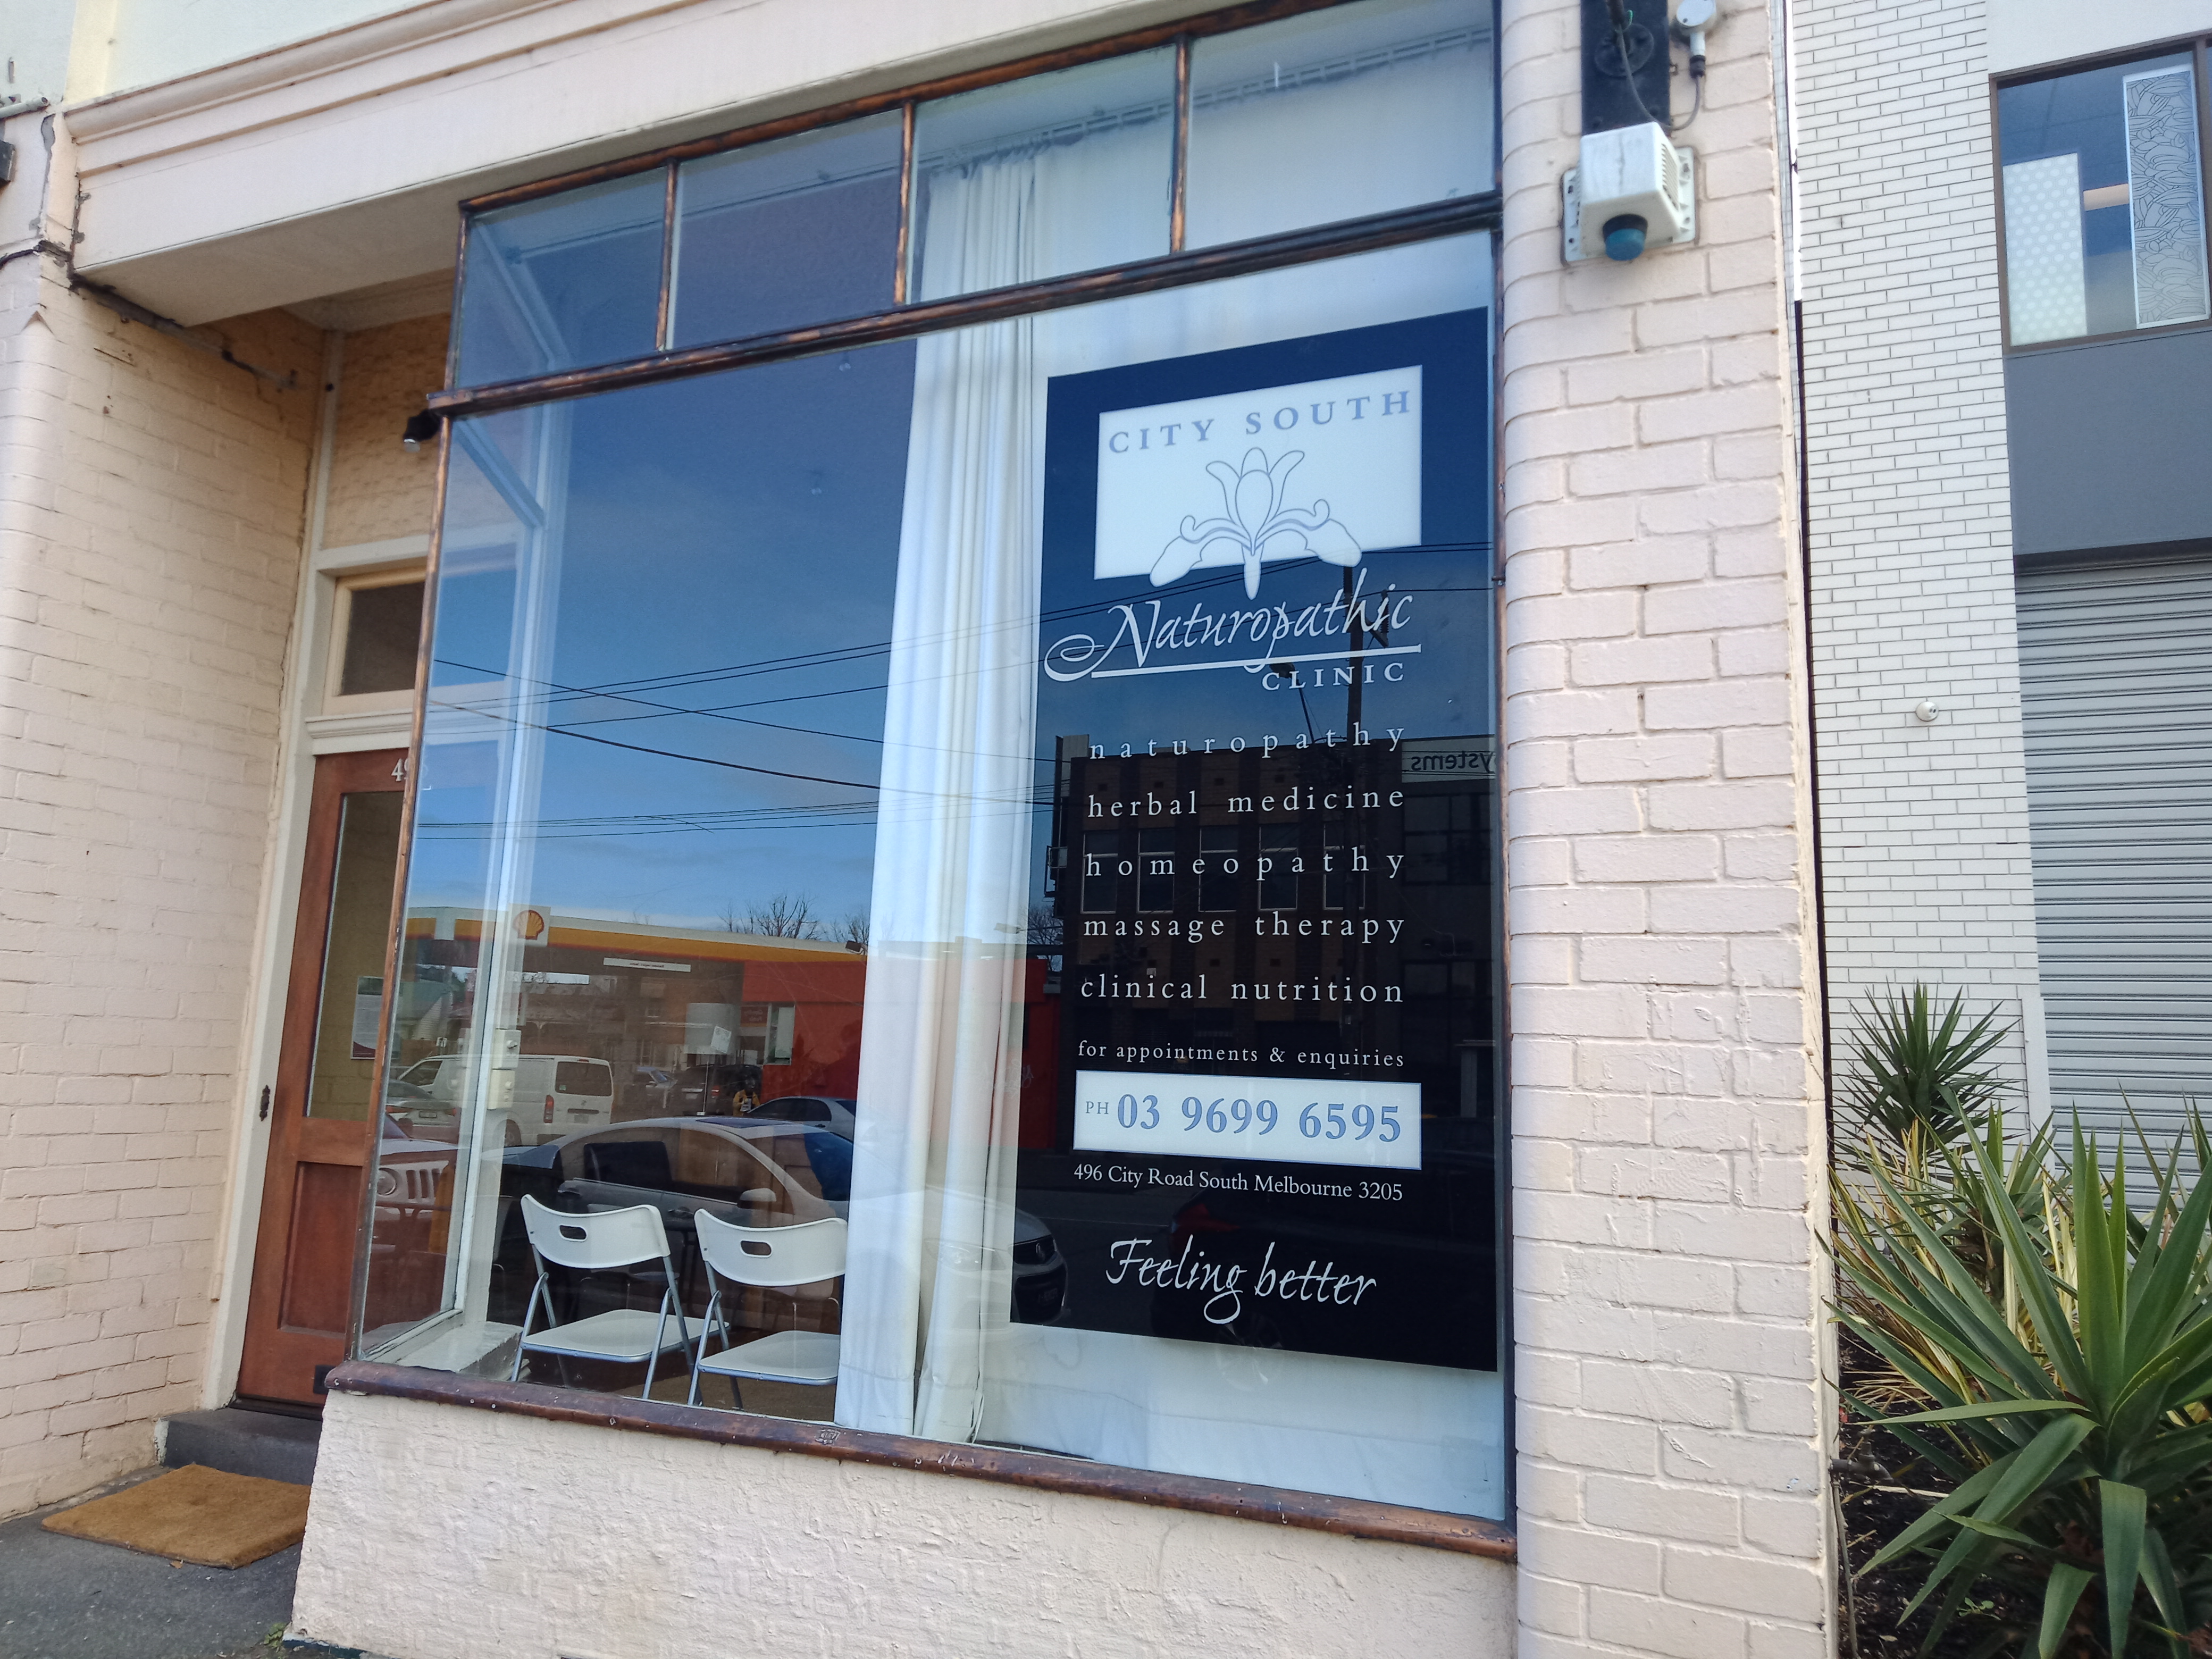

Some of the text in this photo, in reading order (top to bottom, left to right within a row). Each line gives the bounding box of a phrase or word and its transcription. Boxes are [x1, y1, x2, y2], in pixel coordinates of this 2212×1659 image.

[1109, 390, 1410, 453] CITY SOUTH
[1044, 568, 1414, 681] Naturopathic
[1262, 662, 1404, 691] CLINIC
[1090, 722, 1404, 759] naturopathy
[1088, 785, 1403, 817] herbal medicine
[1086, 847, 1404, 881] homeopathy
[1084, 911, 1404, 944] massage therapy
[1081, 974, 1403, 1002] clinical nutrition
[1078, 1040, 1403, 1069] for appointments & enquiries
[1085, 1093, 1401, 1143] PH 03 9699 6595
[1074, 1163, 1403, 1201] 496 City Road South Melbourne 3205
[1105, 1235, 1377, 1324] Feeling better
